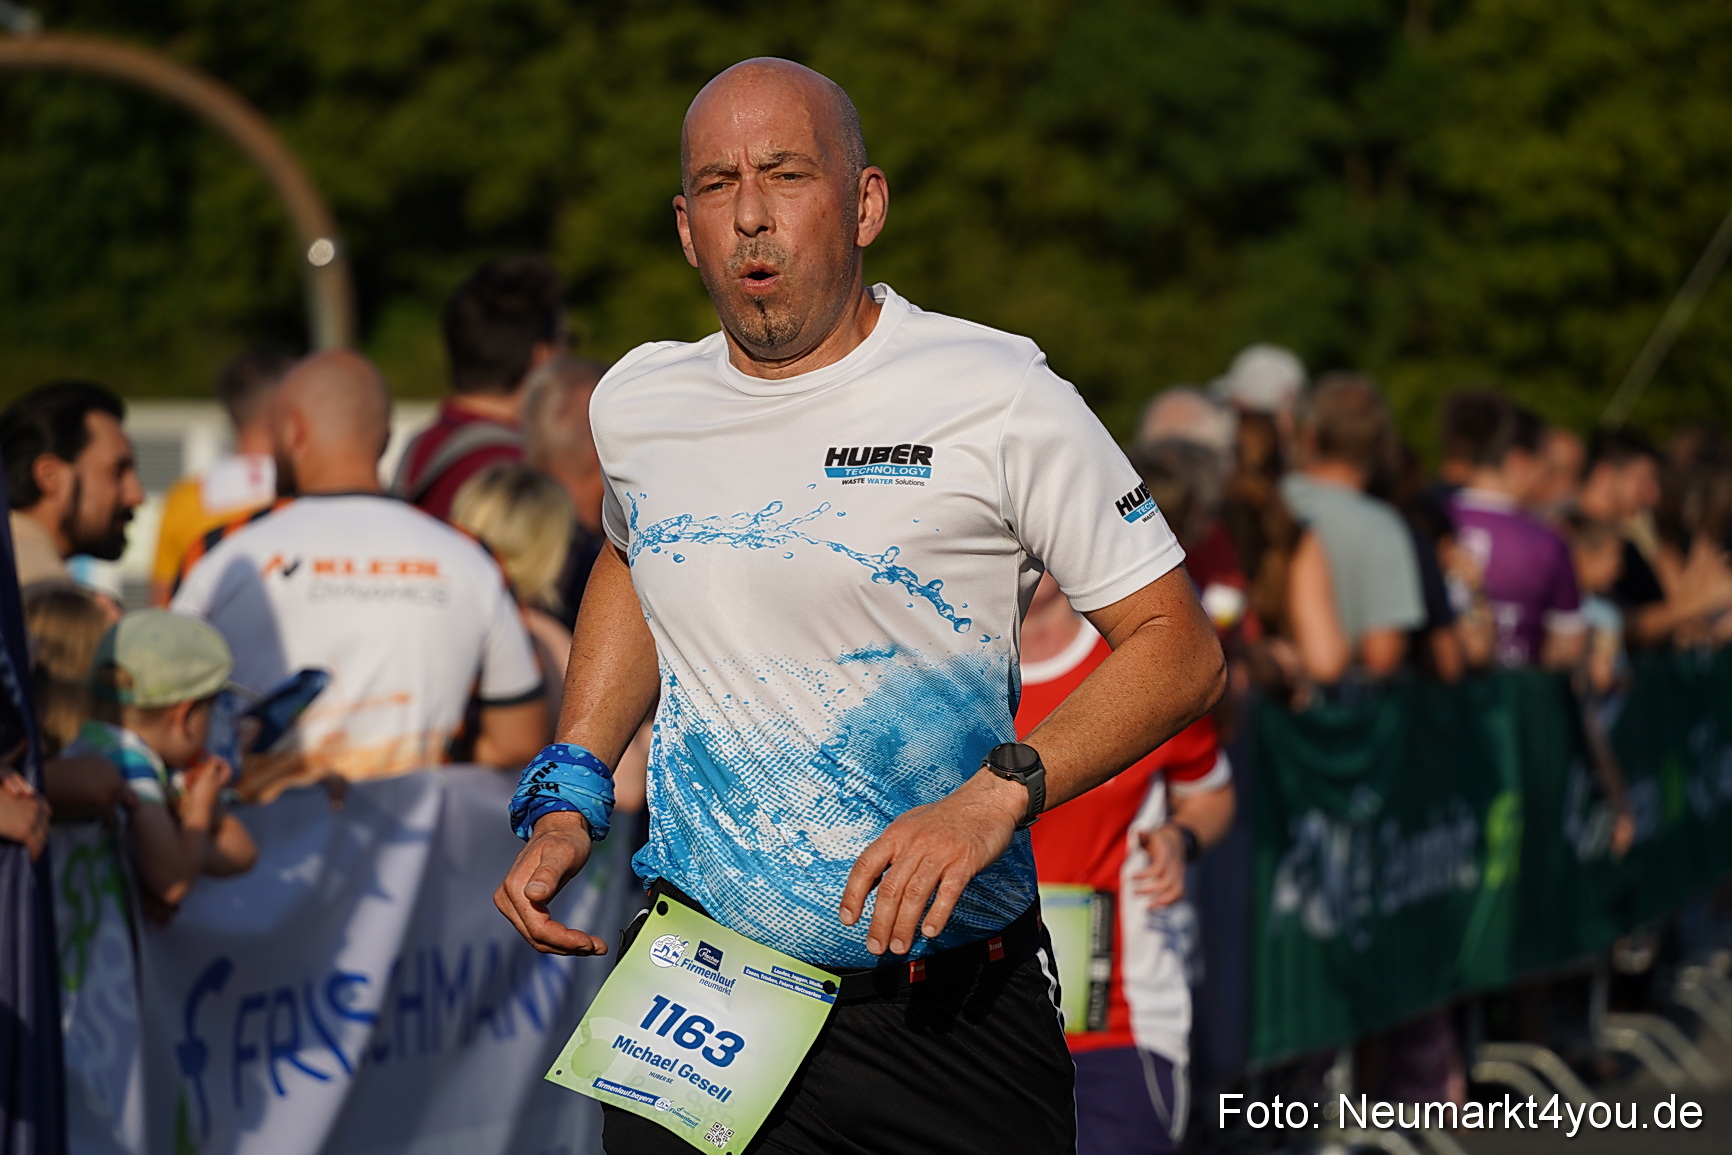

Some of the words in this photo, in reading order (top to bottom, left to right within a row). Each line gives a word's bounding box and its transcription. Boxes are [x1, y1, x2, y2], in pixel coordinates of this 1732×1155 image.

[824, 443, 934, 467] HUBER
[844, 465, 927, 476] TECHNOLOGY
[841, 477, 866, 485] WASTE
[895, 478, 925, 487] Solutions
[680, 958, 736, 988] Firmenlauf
[699, 978, 732, 995] neumarkt
[794, 985, 822, 999] Netzwerken
[639, 994, 746, 1068] 1163
[611, 1034, 680, 1073] Michael
[677, 1063, 733, 1103] Gesell
[648, 1071, 668, 1082] HUBER
[596, 1080, 655, 1104] firmenlauf.bayern
[668, 1107, 699, 1127] Firmenlauf
